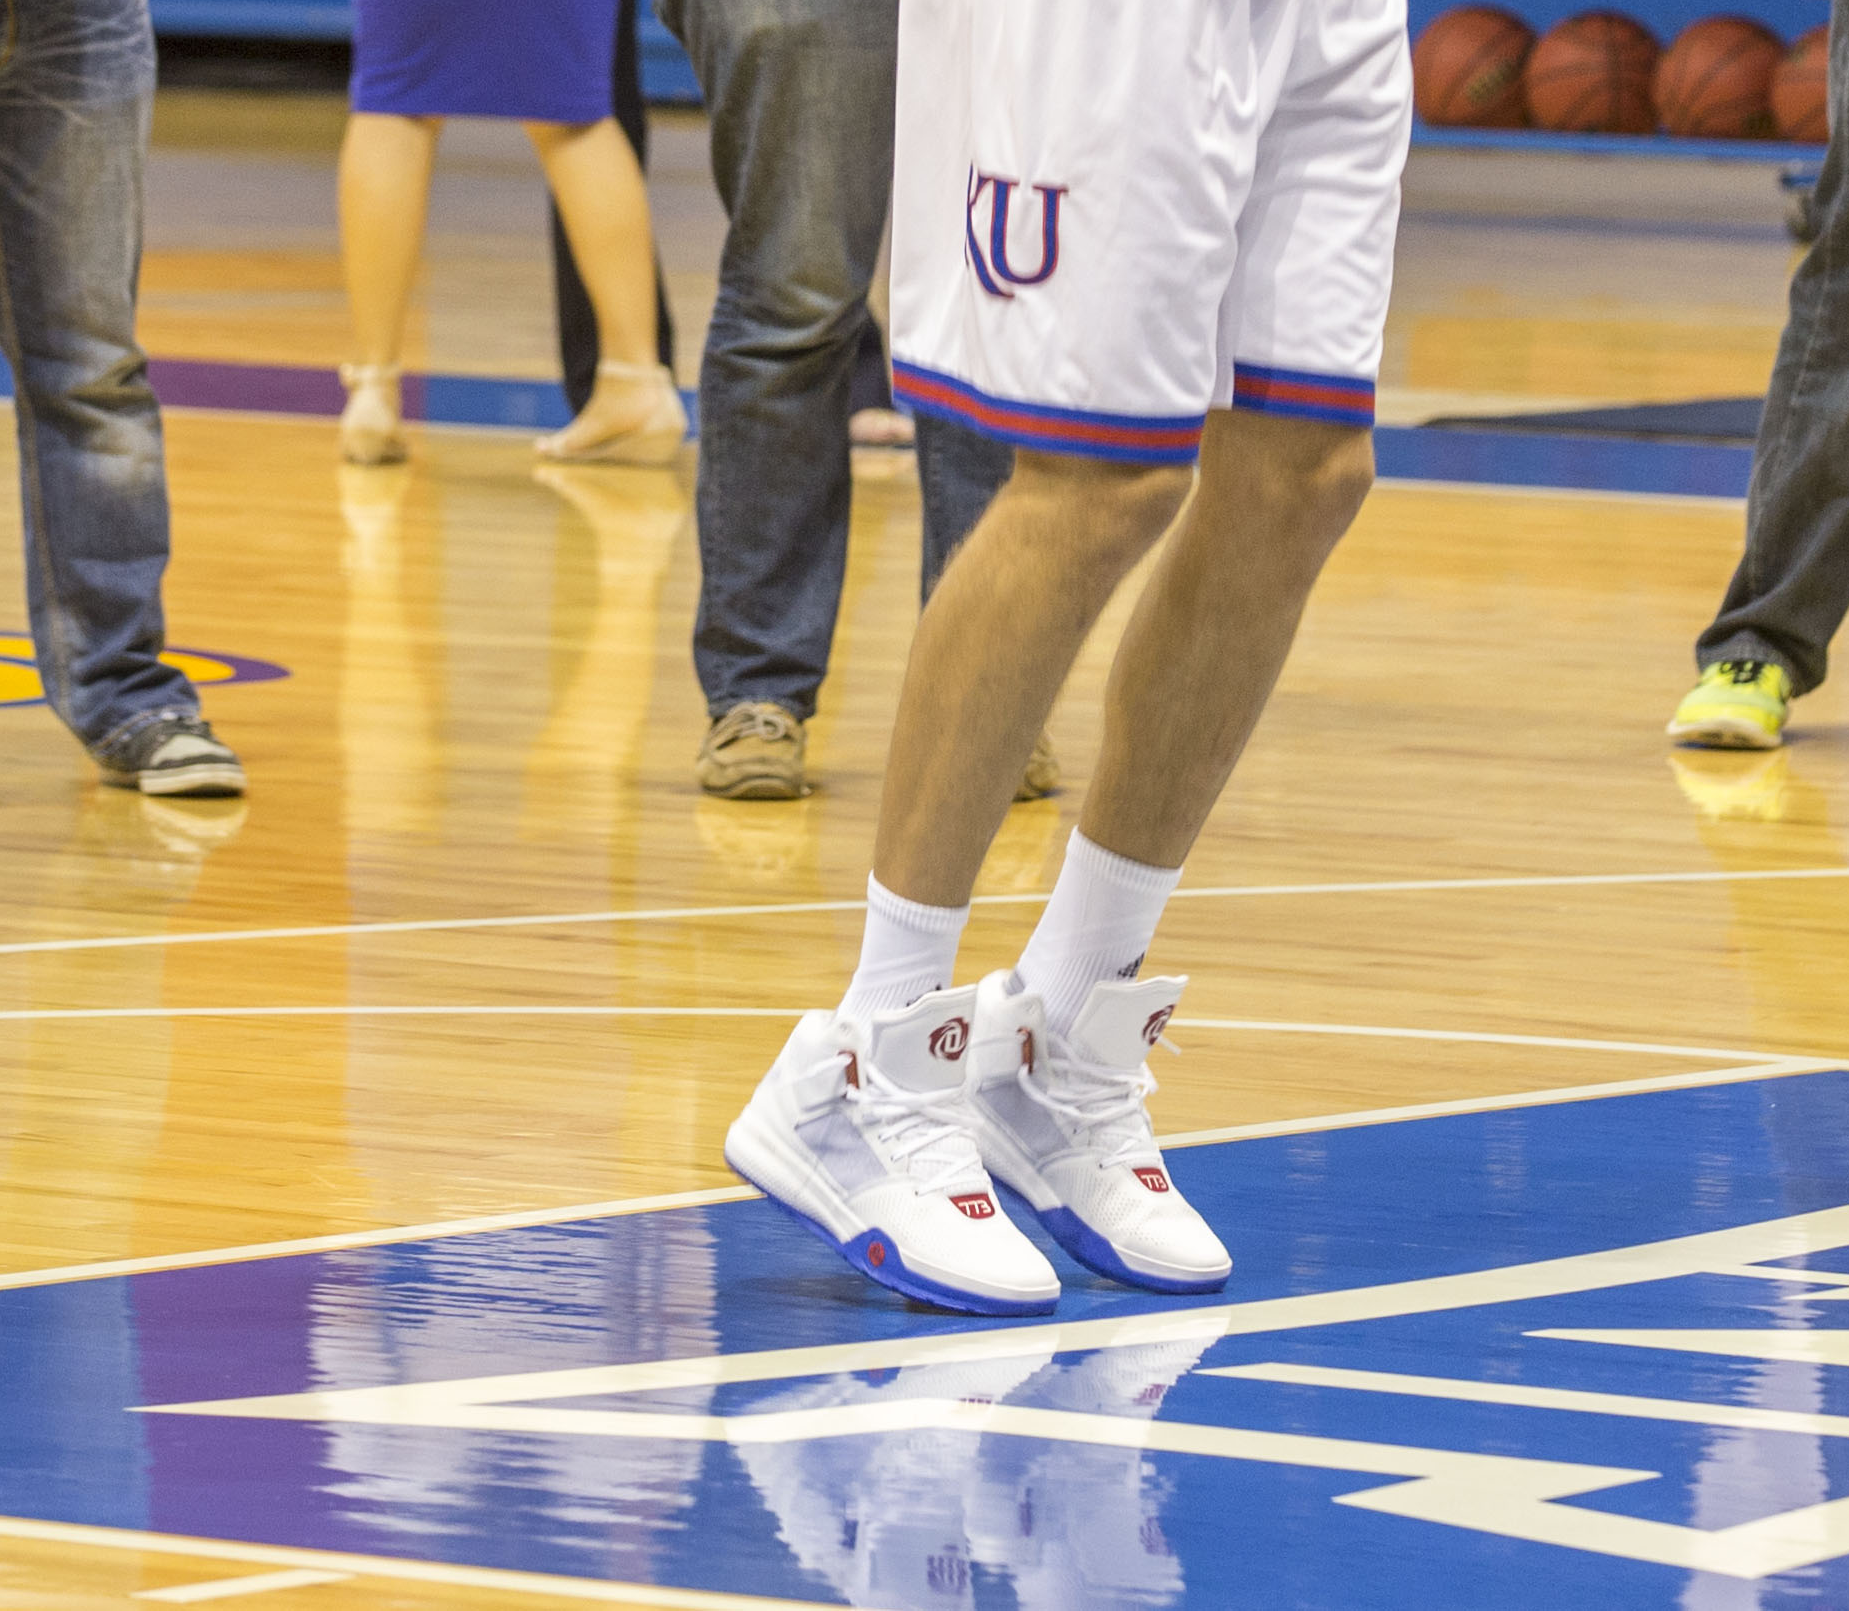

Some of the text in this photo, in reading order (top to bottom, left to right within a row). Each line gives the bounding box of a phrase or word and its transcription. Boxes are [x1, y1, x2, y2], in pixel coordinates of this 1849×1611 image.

[963, 158, 1070, 301] KU
[1139, 1173, 1168, 1191] 773
[957, 1198, 992, 1217] 773
